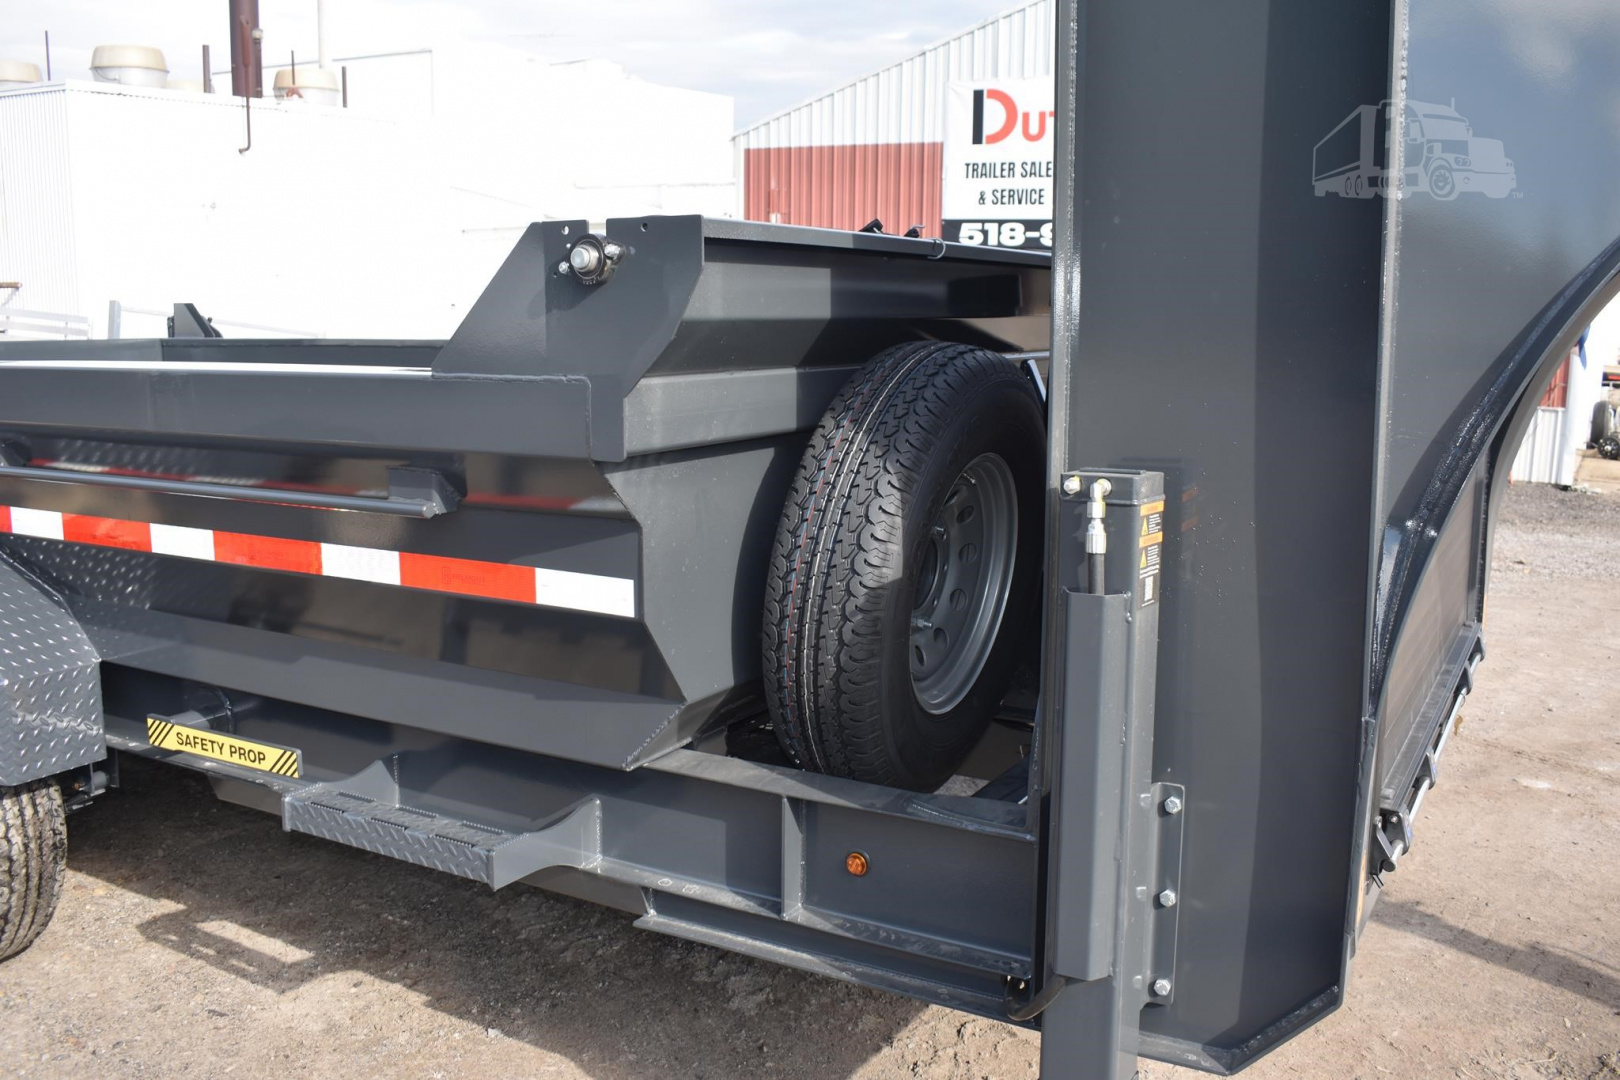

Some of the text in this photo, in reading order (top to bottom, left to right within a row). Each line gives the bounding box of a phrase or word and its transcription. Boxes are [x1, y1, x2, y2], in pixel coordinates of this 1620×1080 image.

[972, 88, 1055, 145] DU
[964, 162, 1016, 179] TRAILER
[978, 188, 1045, 205] & SERVICE
[176, 732, 266, 765] SAFETY PROP
